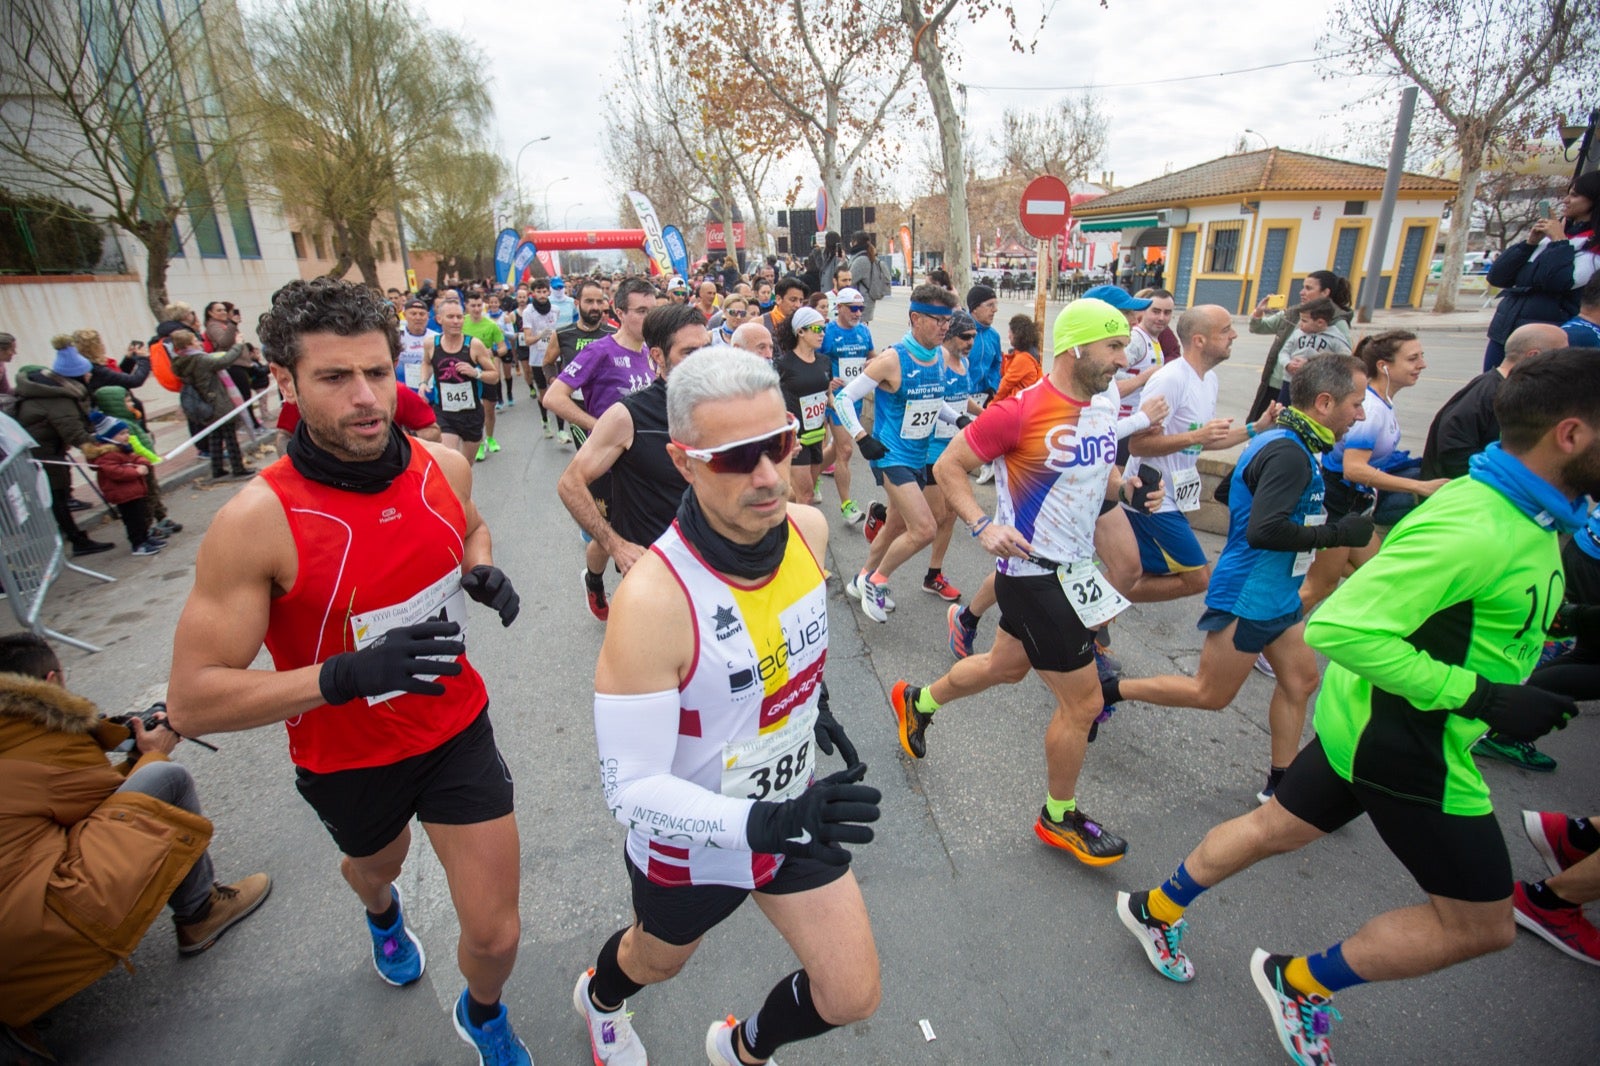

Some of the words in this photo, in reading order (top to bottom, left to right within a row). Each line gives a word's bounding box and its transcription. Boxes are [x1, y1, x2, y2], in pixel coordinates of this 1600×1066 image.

[1298, 335, 1328, 353] GAP
[447, 391, 468, 402] 845
[805, 402, 825, 420] 209
[911, 410, 937, 426] 237
[1175, 481, 1199, 502] 3077
[747, 741, 810, 801] 388
[632, 806, 727, 833] INTERNACIONAL
